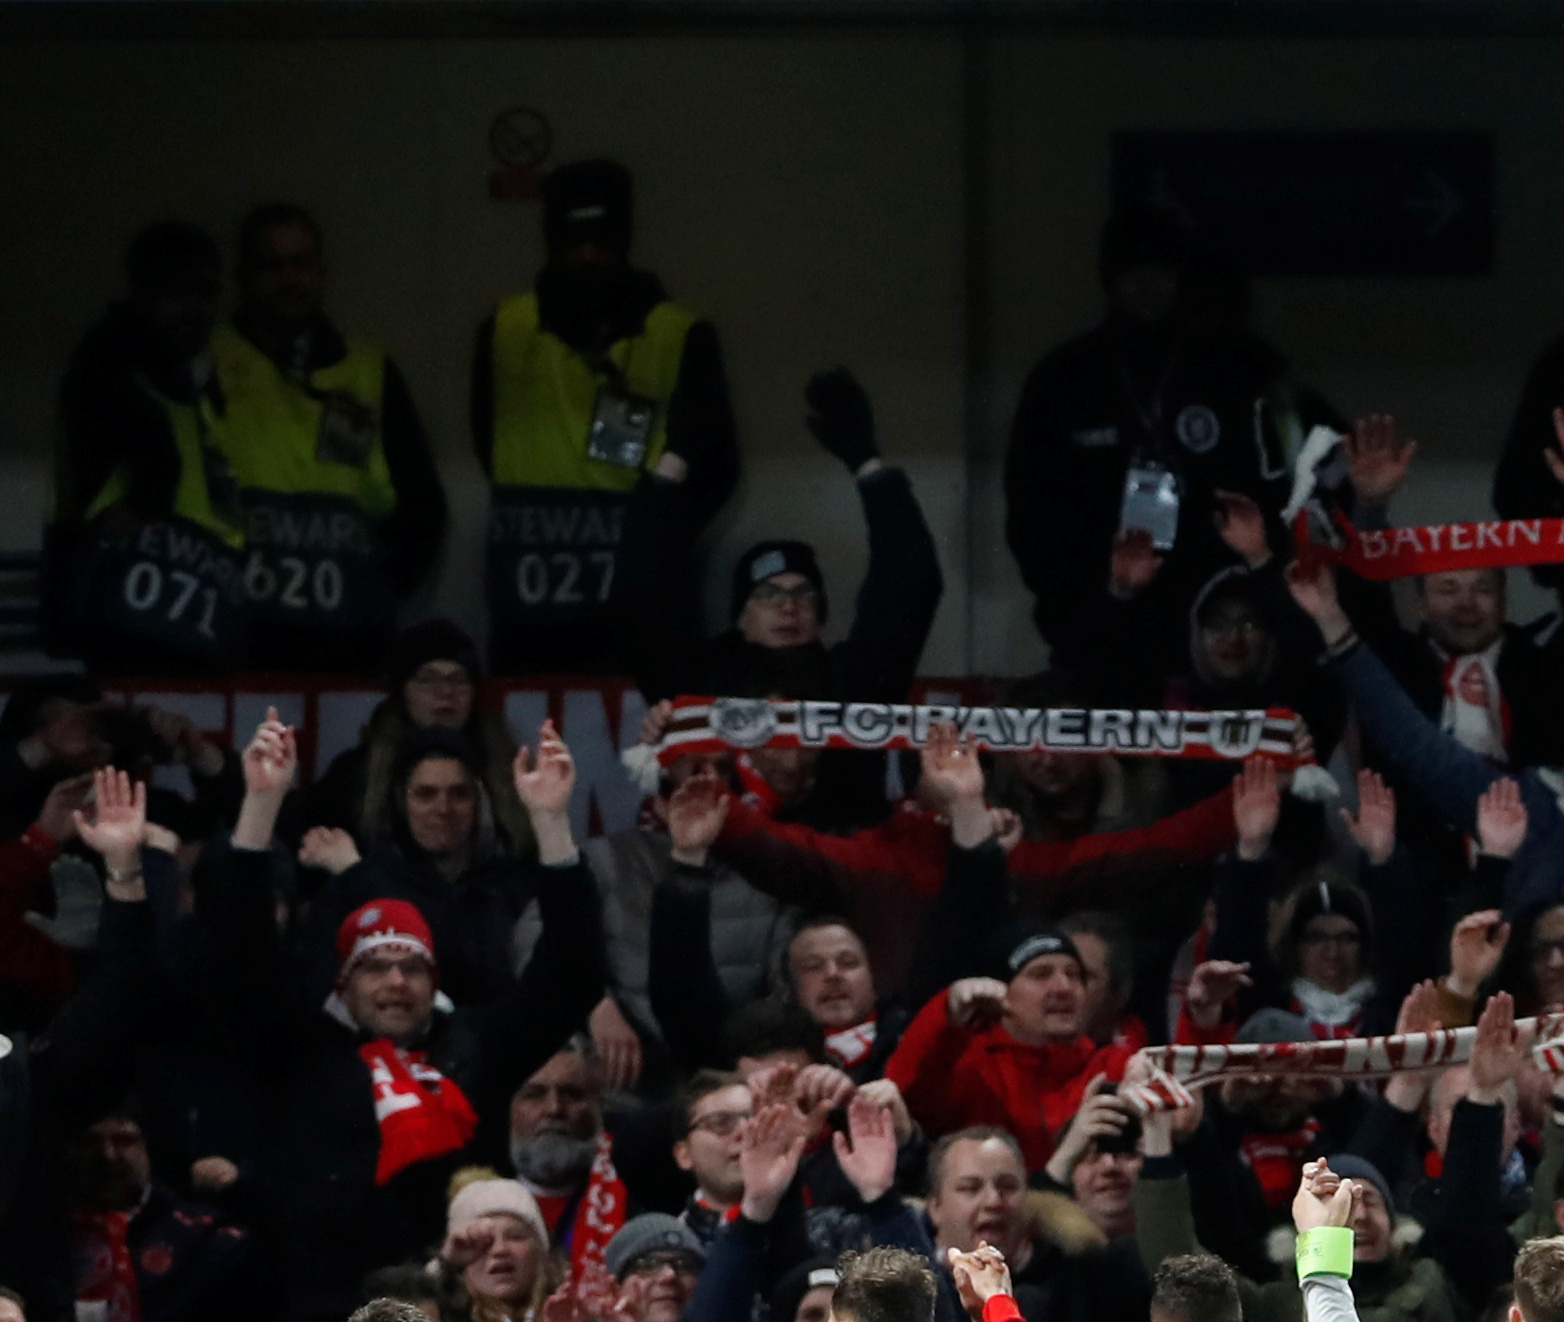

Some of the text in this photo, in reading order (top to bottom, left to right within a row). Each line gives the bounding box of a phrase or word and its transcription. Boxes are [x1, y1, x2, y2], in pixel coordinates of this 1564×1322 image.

[1360, 517, 1541, 561] BAYERN
[123, 561, 218, 640] 071
[243, 550, 344, 611] 620
[516, 551, 616, 606] 027
[801, 702, 1186, 749] FC BAYERN
